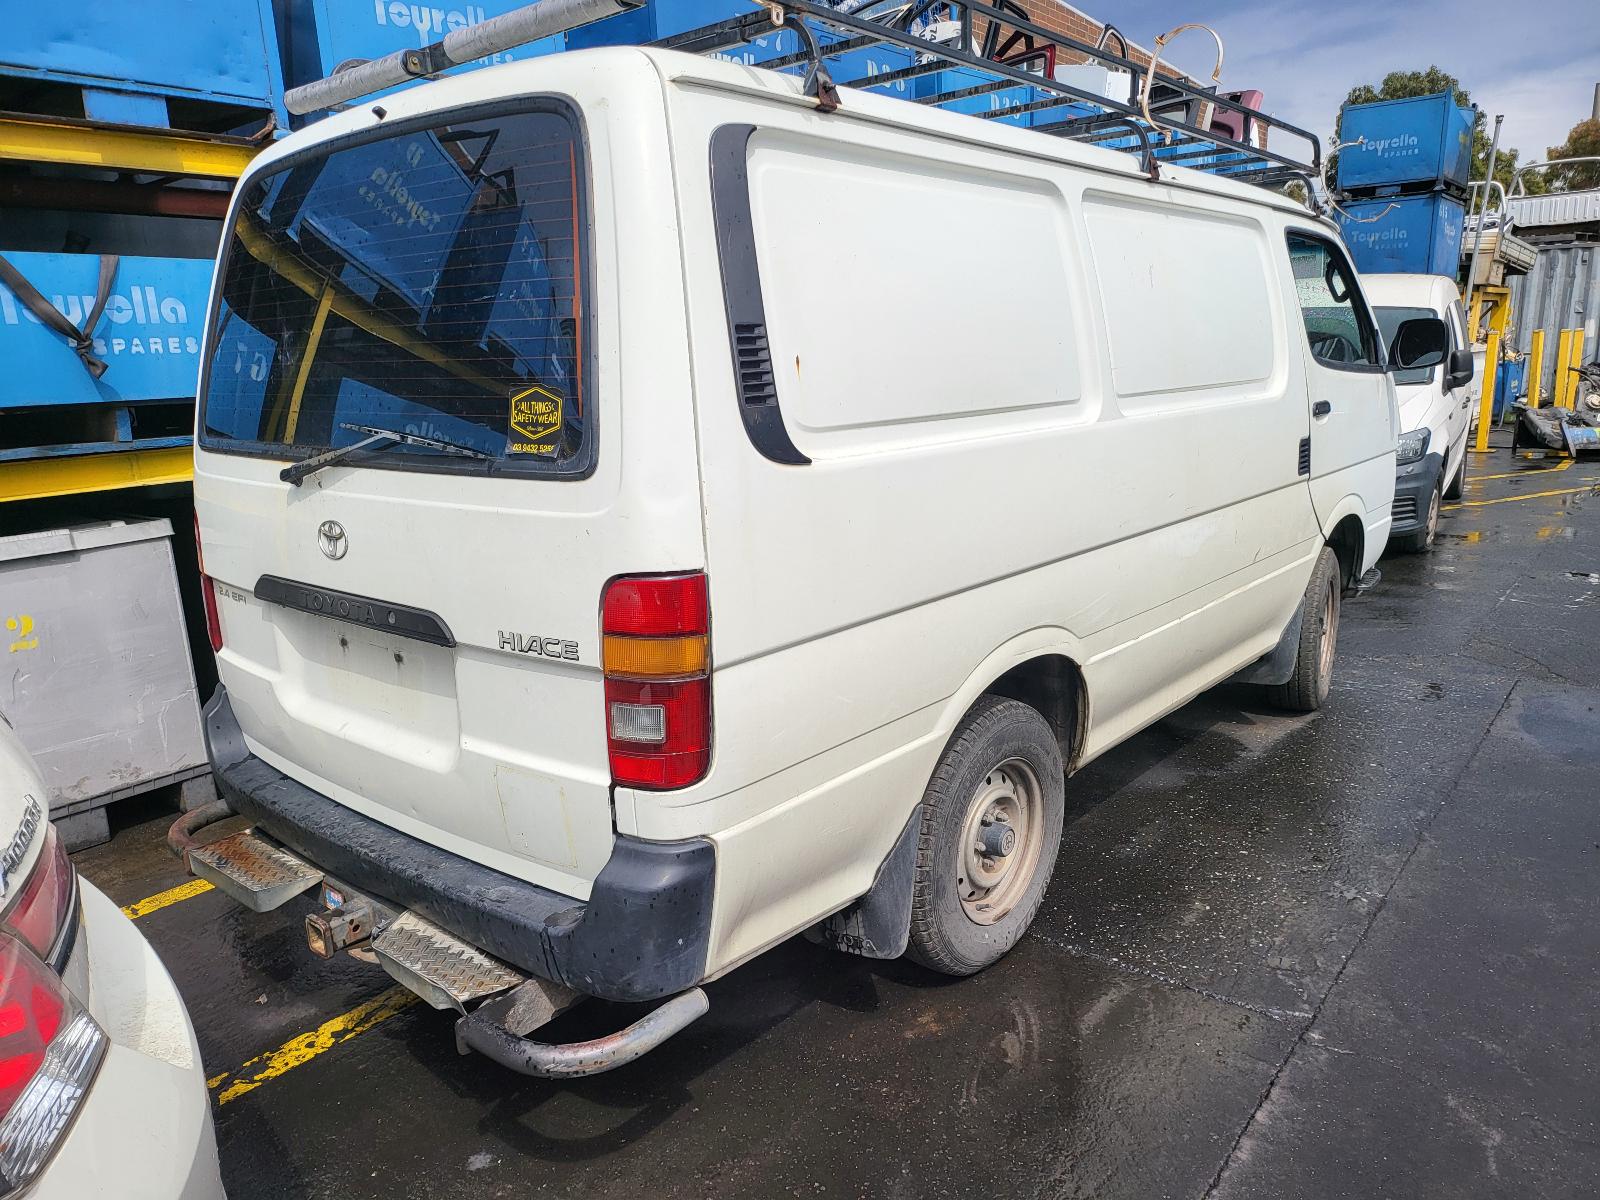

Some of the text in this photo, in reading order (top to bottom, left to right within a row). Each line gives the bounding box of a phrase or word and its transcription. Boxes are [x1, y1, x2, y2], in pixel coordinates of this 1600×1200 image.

[93, 336, 199, 355] SPARES
[520, 401, 552, 414] ALL THINGS
[512, 410, 558, 424] SAFETY WEAR
[232, 592, 247, 604] EFI
[301, 589, 378, 624] TOYOTA
[497, 630, 580, 661] HIACE
